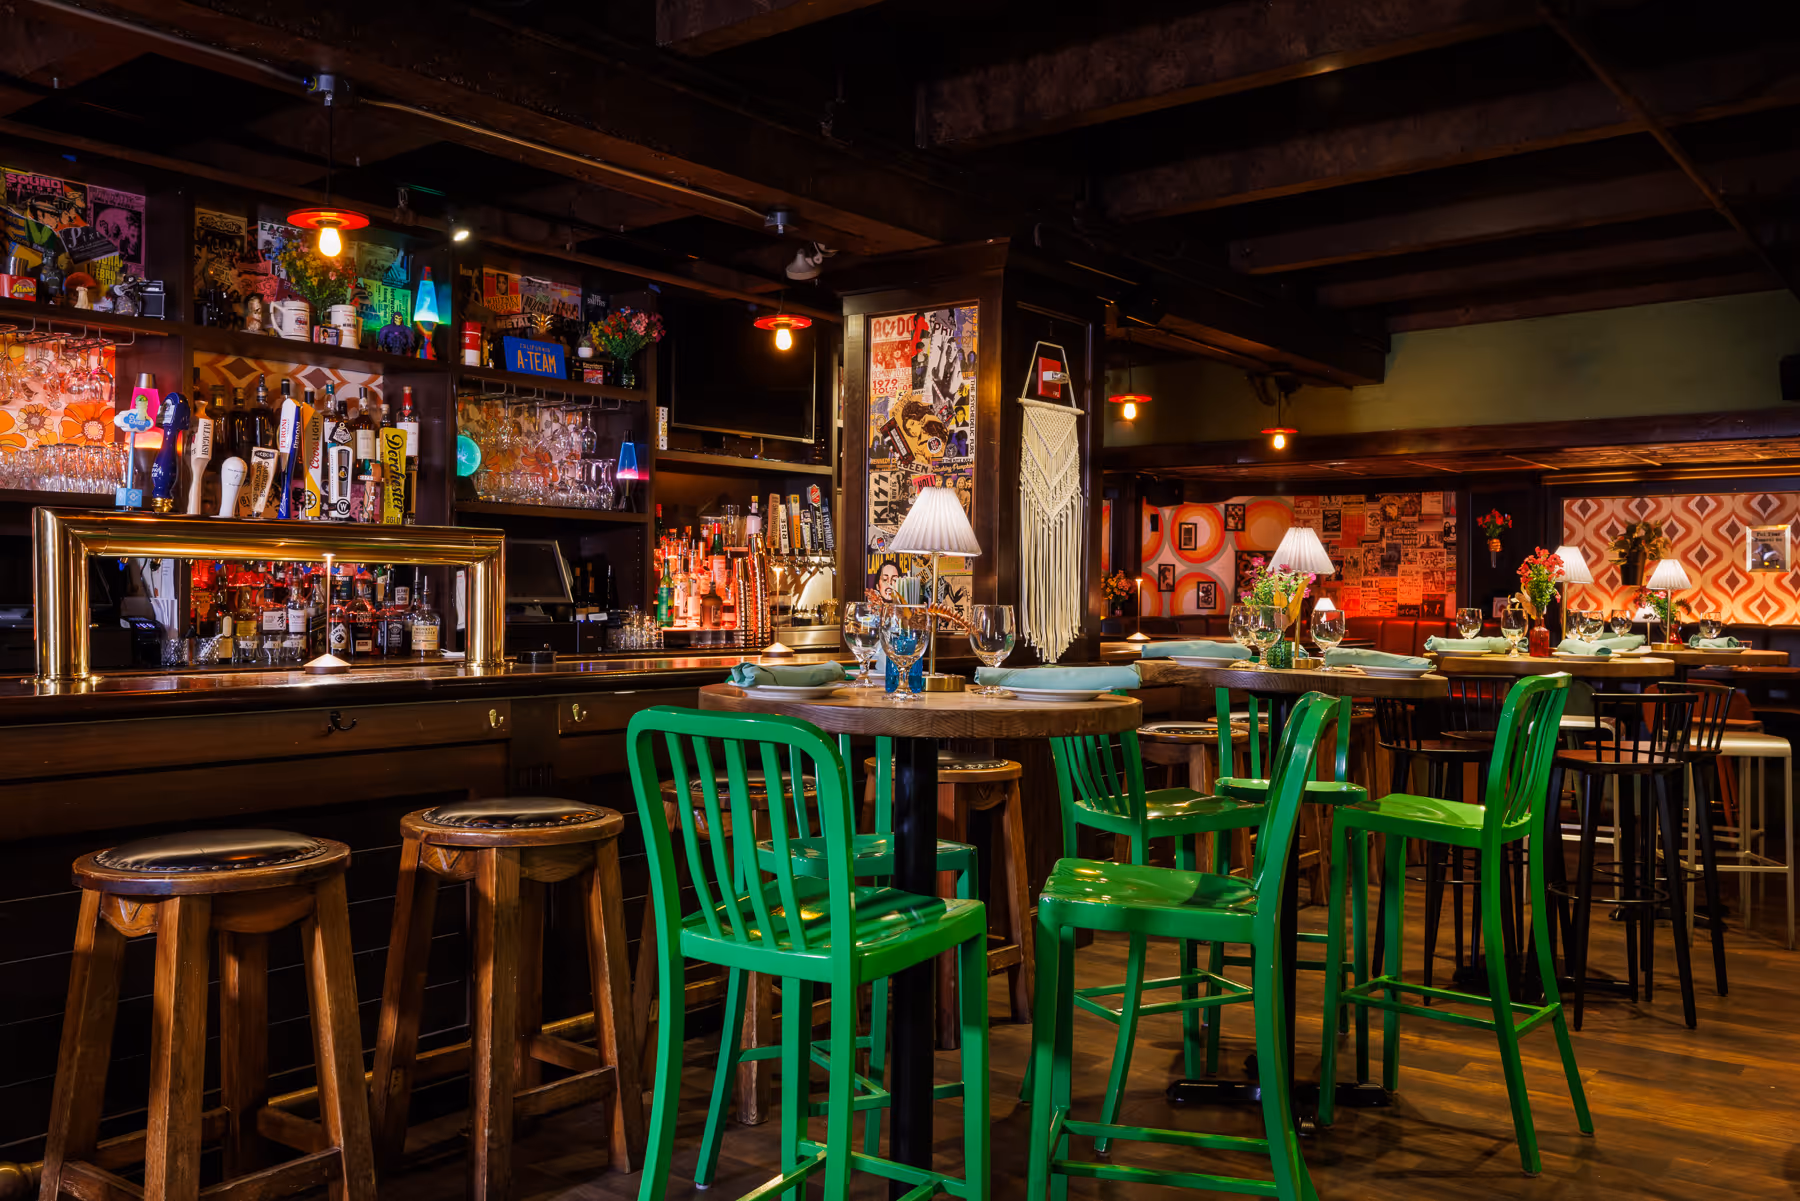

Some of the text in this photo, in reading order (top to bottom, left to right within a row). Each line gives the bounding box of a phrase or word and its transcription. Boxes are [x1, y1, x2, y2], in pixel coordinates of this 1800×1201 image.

[5, 173, 62, 190] SOUND
[485, 295, 520, 306] WHITNEY
[517, 350, 557, 374] A-TEAM
[872, 378, 898, 388] 1979
[201, 421, 213, 456] ALLAGASH
[293, 420, 301, 449] PERONI
[310, 416, 320, 470] Coors LIGHT
[260, 461, 270, 498] CAMBRIDGE
[385, 434, 406, 513] Dorchester
[873, 474, 889, 524] KISS
[385, 515, 401, 525] GOLD
[899, 553, 912, 574] REY
